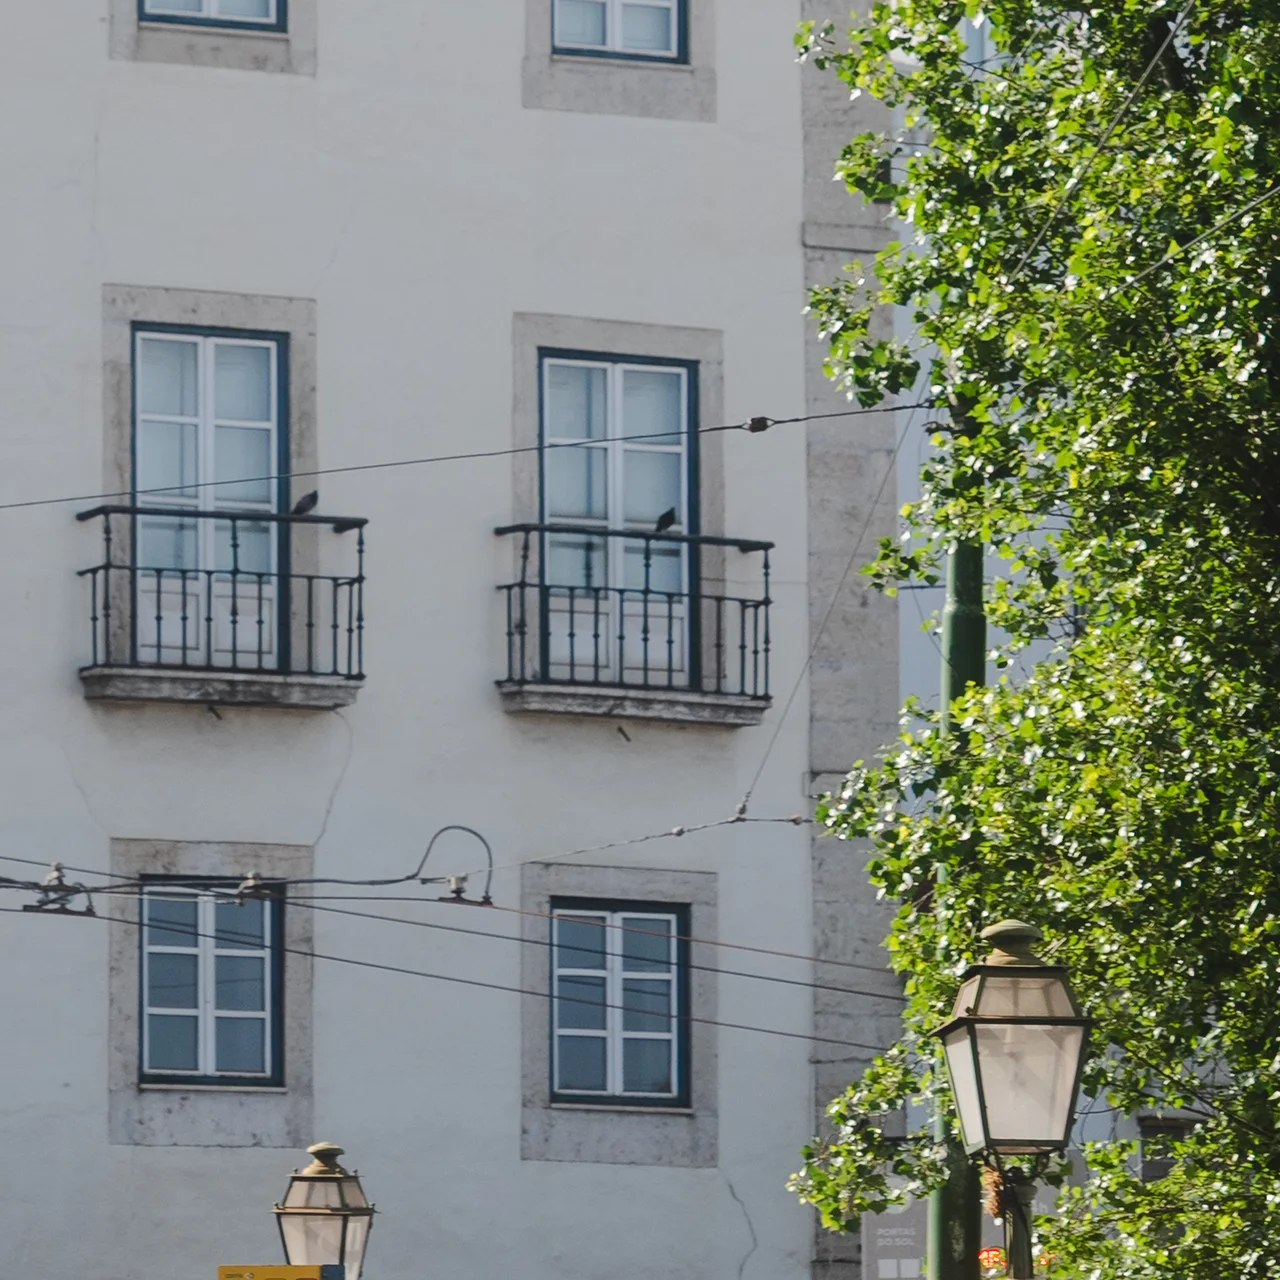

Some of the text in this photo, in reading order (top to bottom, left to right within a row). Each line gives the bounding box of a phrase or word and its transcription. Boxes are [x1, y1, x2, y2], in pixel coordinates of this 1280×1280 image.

[876, 1228, 916, 1236] PORTAS
[877, 1238, 915, 1246] DO SOL
